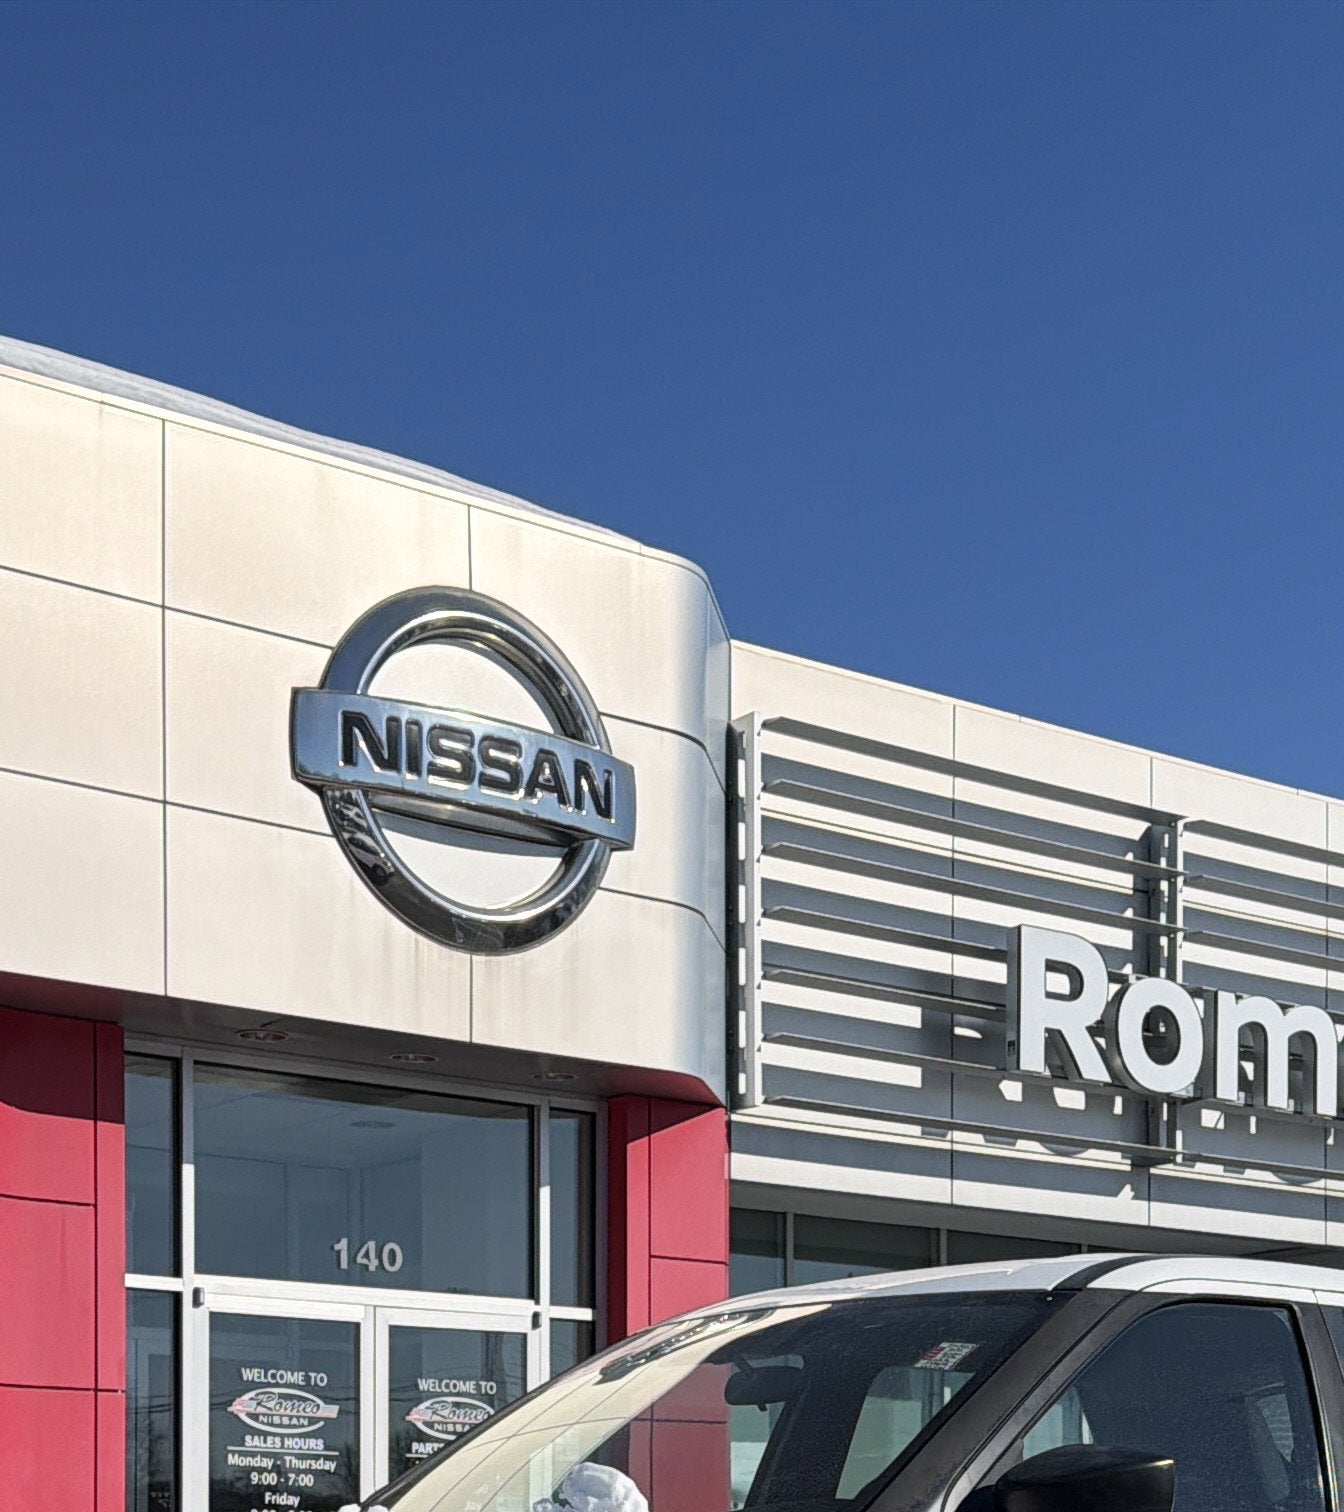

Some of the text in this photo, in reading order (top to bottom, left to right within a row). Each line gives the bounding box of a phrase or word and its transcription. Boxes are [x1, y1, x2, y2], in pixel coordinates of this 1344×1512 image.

[338, 709, 615, 823] NISSAN
[333, 1237, 404, 1273] 140
[241, 1367, 328, 1387] WELCOME TO
[417, 1378, 497, 1395] WELCOME TO
[254, 1391, 321, 1414] Romeo
[258, 1415, 309, 1426] NISSAN
[433, 1423, 474, 1432] NISSA
[244, 1435, 325, 1451] SALES HOURS
[227, 1453, 275, 1469] Monday
[284, 1455, 337, 1473] Thursday
[250, 1472, 278, 1486] 9:00
[288, 1473, 315, 1487] 7:00
[264, 1492, 301, 1508] Friday
